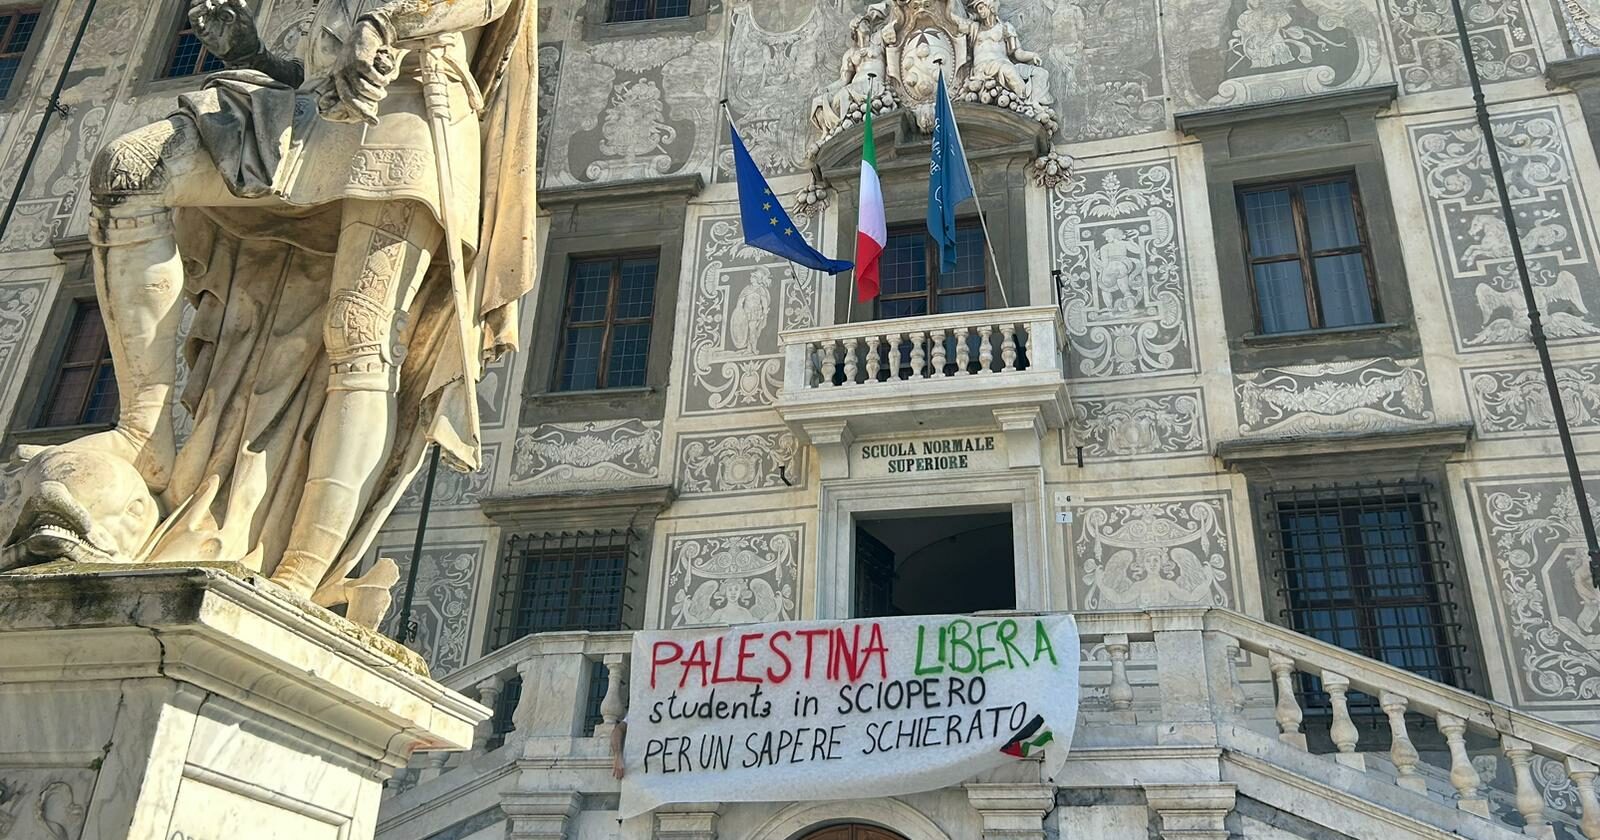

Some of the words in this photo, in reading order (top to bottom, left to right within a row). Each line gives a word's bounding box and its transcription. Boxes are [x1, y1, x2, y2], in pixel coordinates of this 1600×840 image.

[862, 442, 916, 459] SCUOLA
[923, 436, 995, 454] NORMALE
[888, 455, 968, 473] SUPERIORE
[650, 623, 889, 689] PALESTINA
[914, 619, 1057, 675] LIBERA
[794, 691, 818, 717] in
[838, 676, 986, 714] SCIOPERO
[644, 736, 692, 774] PER
[700, 734, 733, 770] UN
[742, 725, 846, 769] SAPERE
[862, 701, 1027, 754] SCHIERATO
